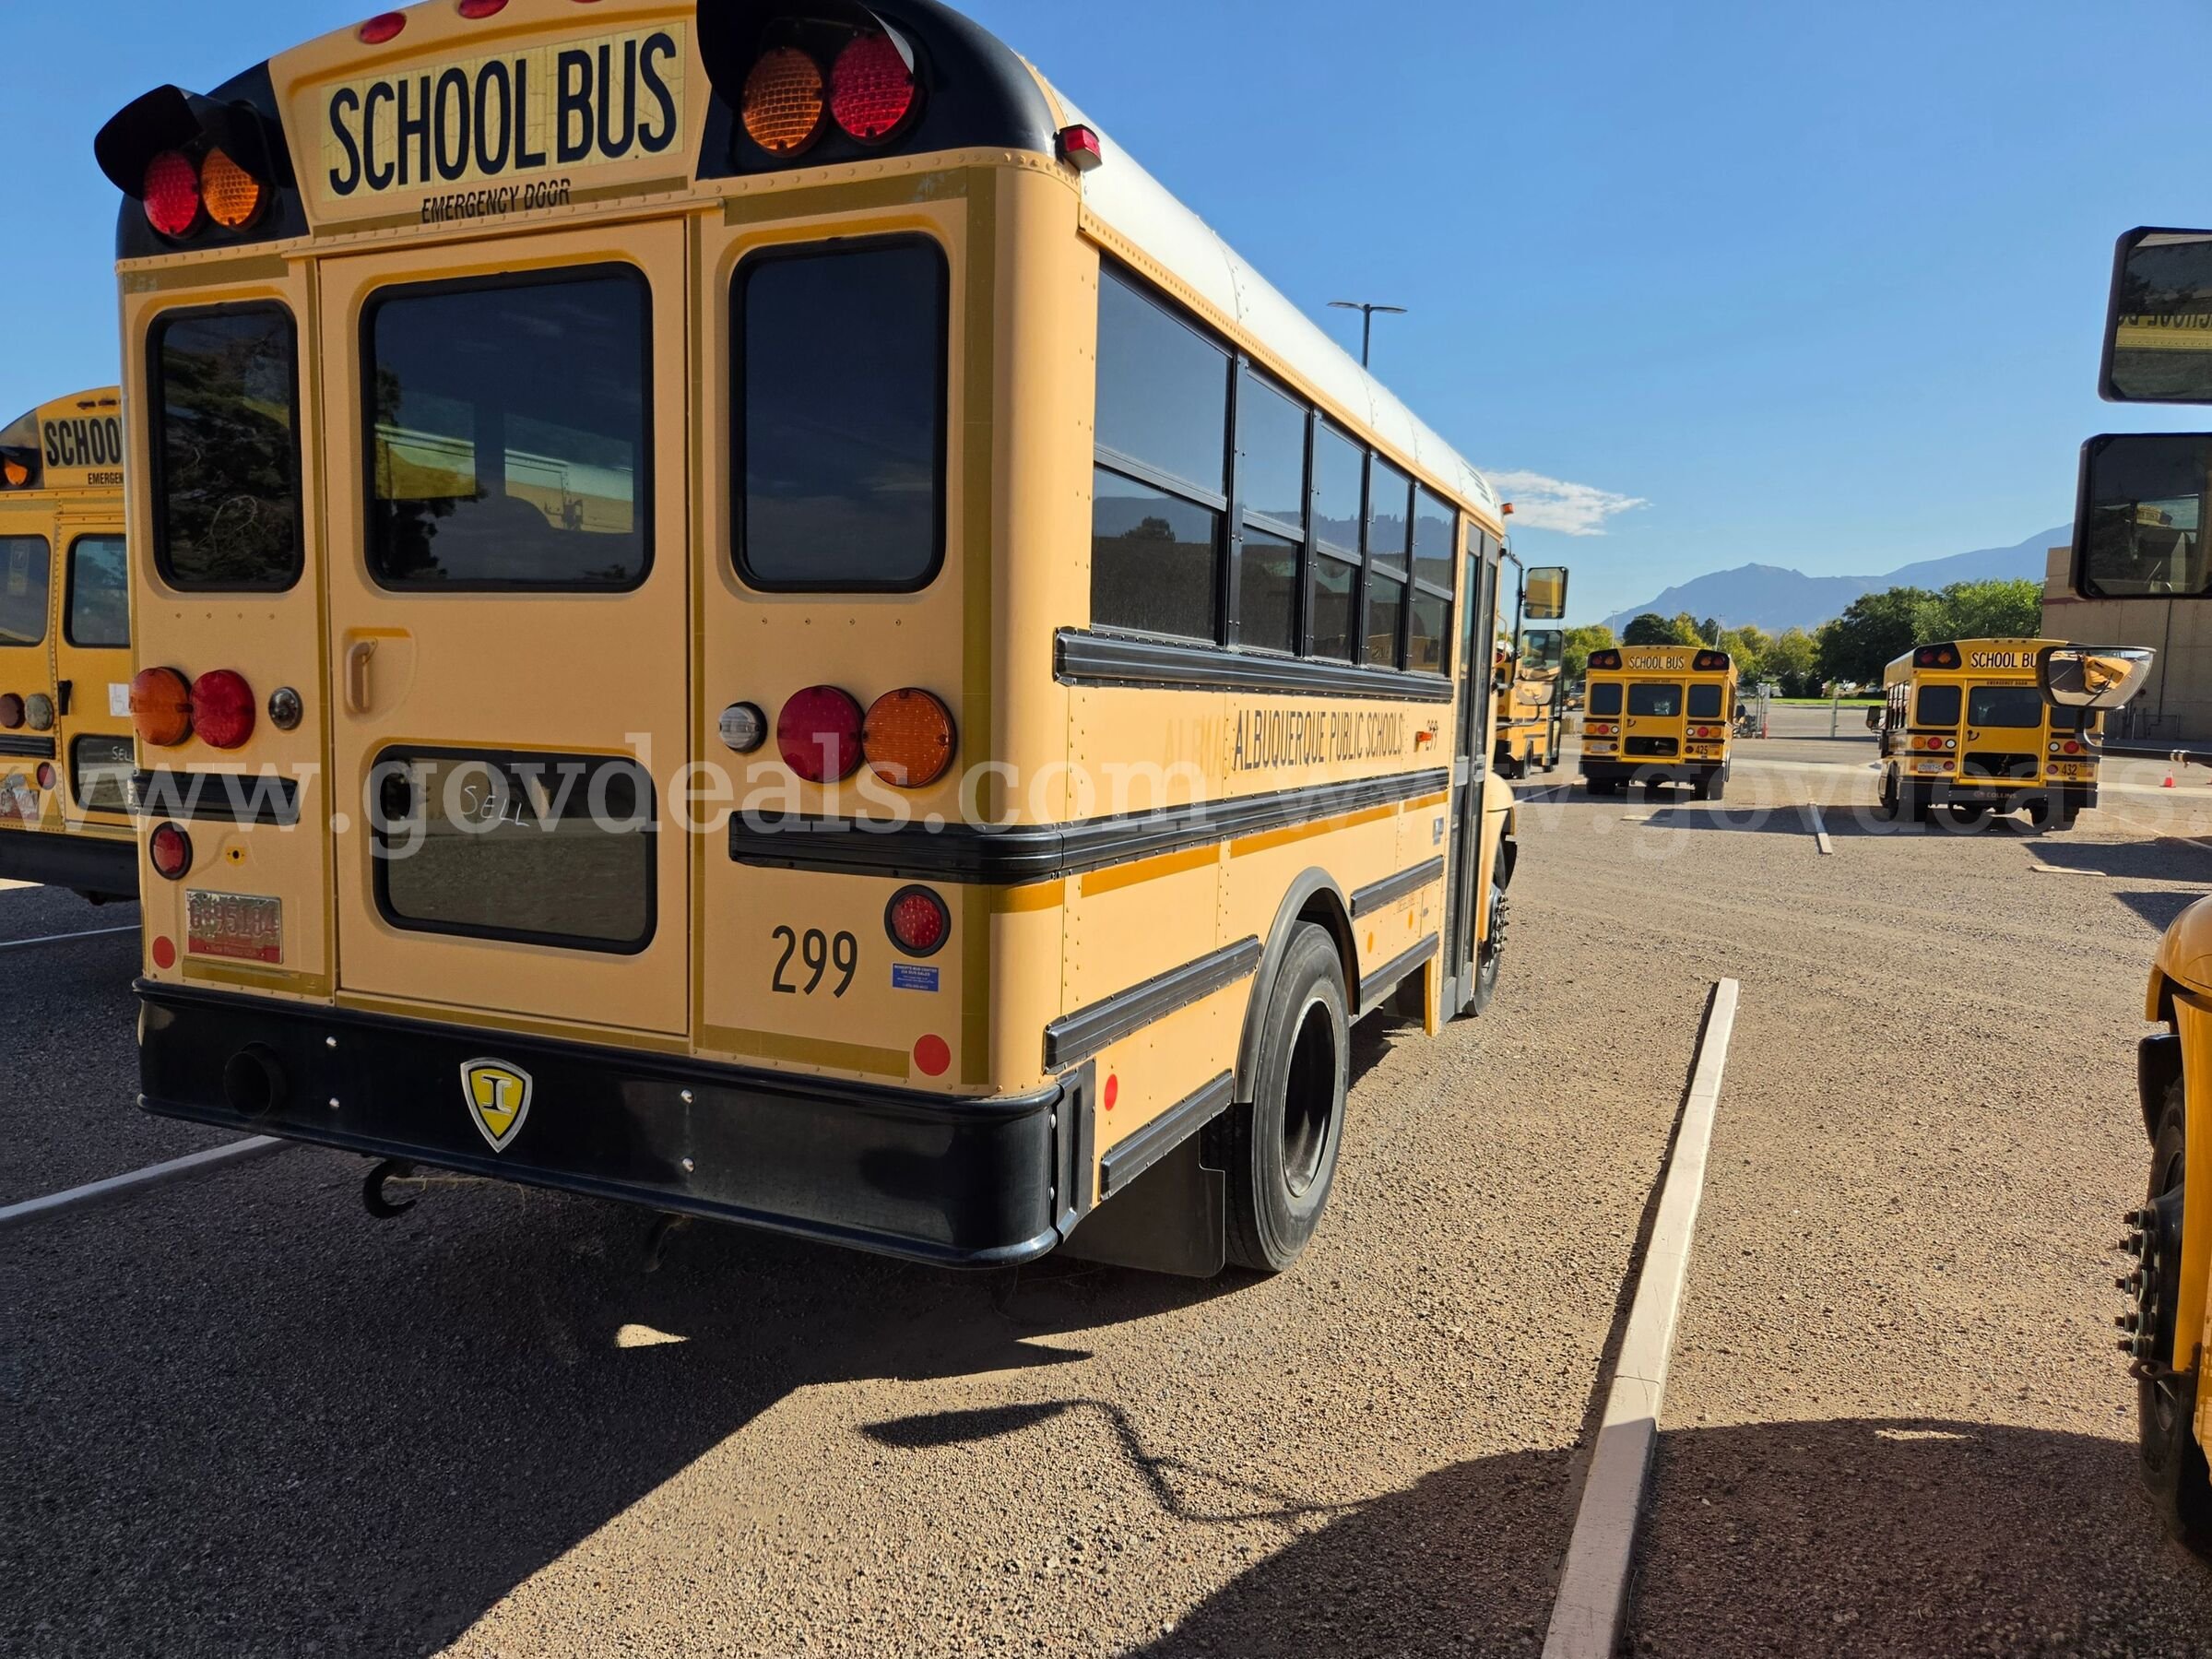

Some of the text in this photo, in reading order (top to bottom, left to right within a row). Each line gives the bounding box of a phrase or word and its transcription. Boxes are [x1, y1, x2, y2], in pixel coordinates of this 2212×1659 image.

[328, 31, 678, 197] SCHOOL BUS
[420, 177, 572, 225] EMERGENCY DOOR
[44, 417, 123, 467] SCHOO
[1629, 656, 1685, 670] SCHOOL BUS
[1970, 652, 2038, 668] SCHOOL BU
[1233, 709, 1327, 773] ALBUQUERQUE
[1328, 711, 1364, 762] PUBLIC
[1366, 712, 1404, 757] SCHOOLS
[1695, 744, 1709, 754] 425
[2062, 764, 2077, 776] 432
[463, 785, 530, 827] SELL
[772, 925, 858, 999] 299
